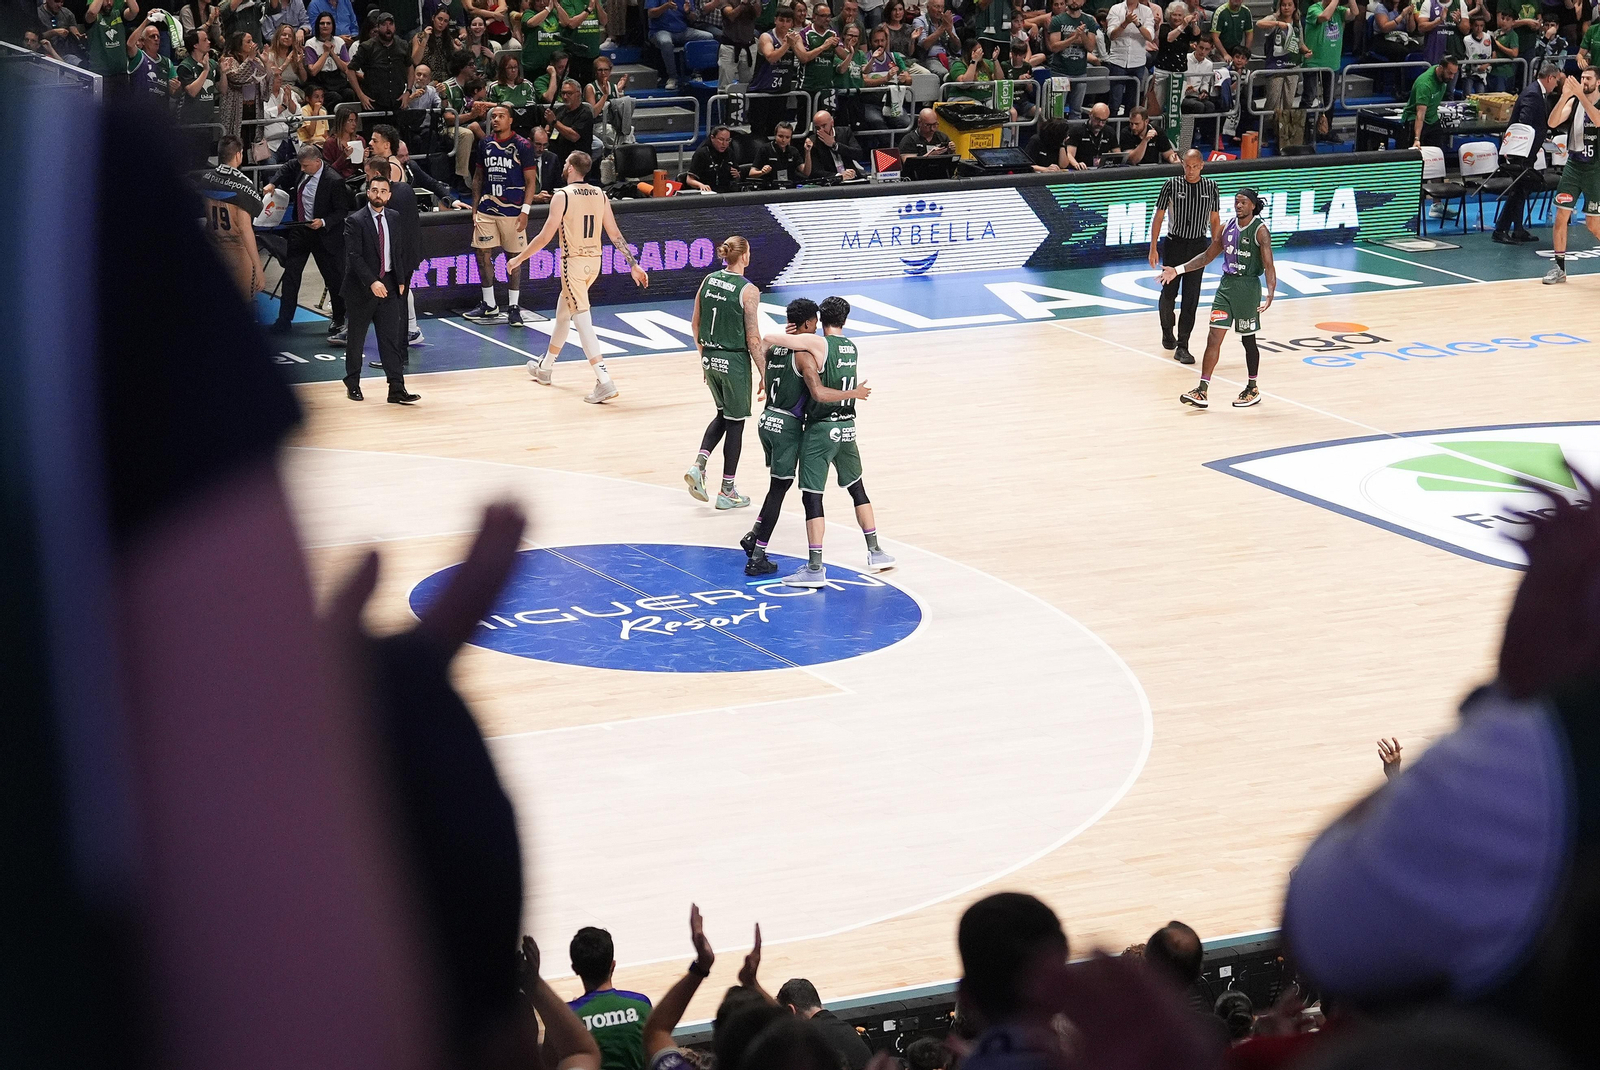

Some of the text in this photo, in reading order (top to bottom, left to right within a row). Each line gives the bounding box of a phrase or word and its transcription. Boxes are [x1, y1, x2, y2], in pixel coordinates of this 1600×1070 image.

[771, 77, 783, 88] 34
[1001, 80, 1011, 107] nicaja
[484, 156, 513, 169] UCAM
[1581, 144, 1594, 158] 45
[224, 178, 262, 202] deportistas
[491, 183, 503, 197] 10
[212, 205, 231, 231] 19
[583, 214, 595, 239] 11
[841, 220, 996, 249] MARBELLA
[710, 307, 718, 336] 1
[710, 357, 729, 366] COSTA
[1302, 332, 1591, 368] endesa
[766, 416, 784, 425] COSTA
[620, 602, 782, 640] Resort
